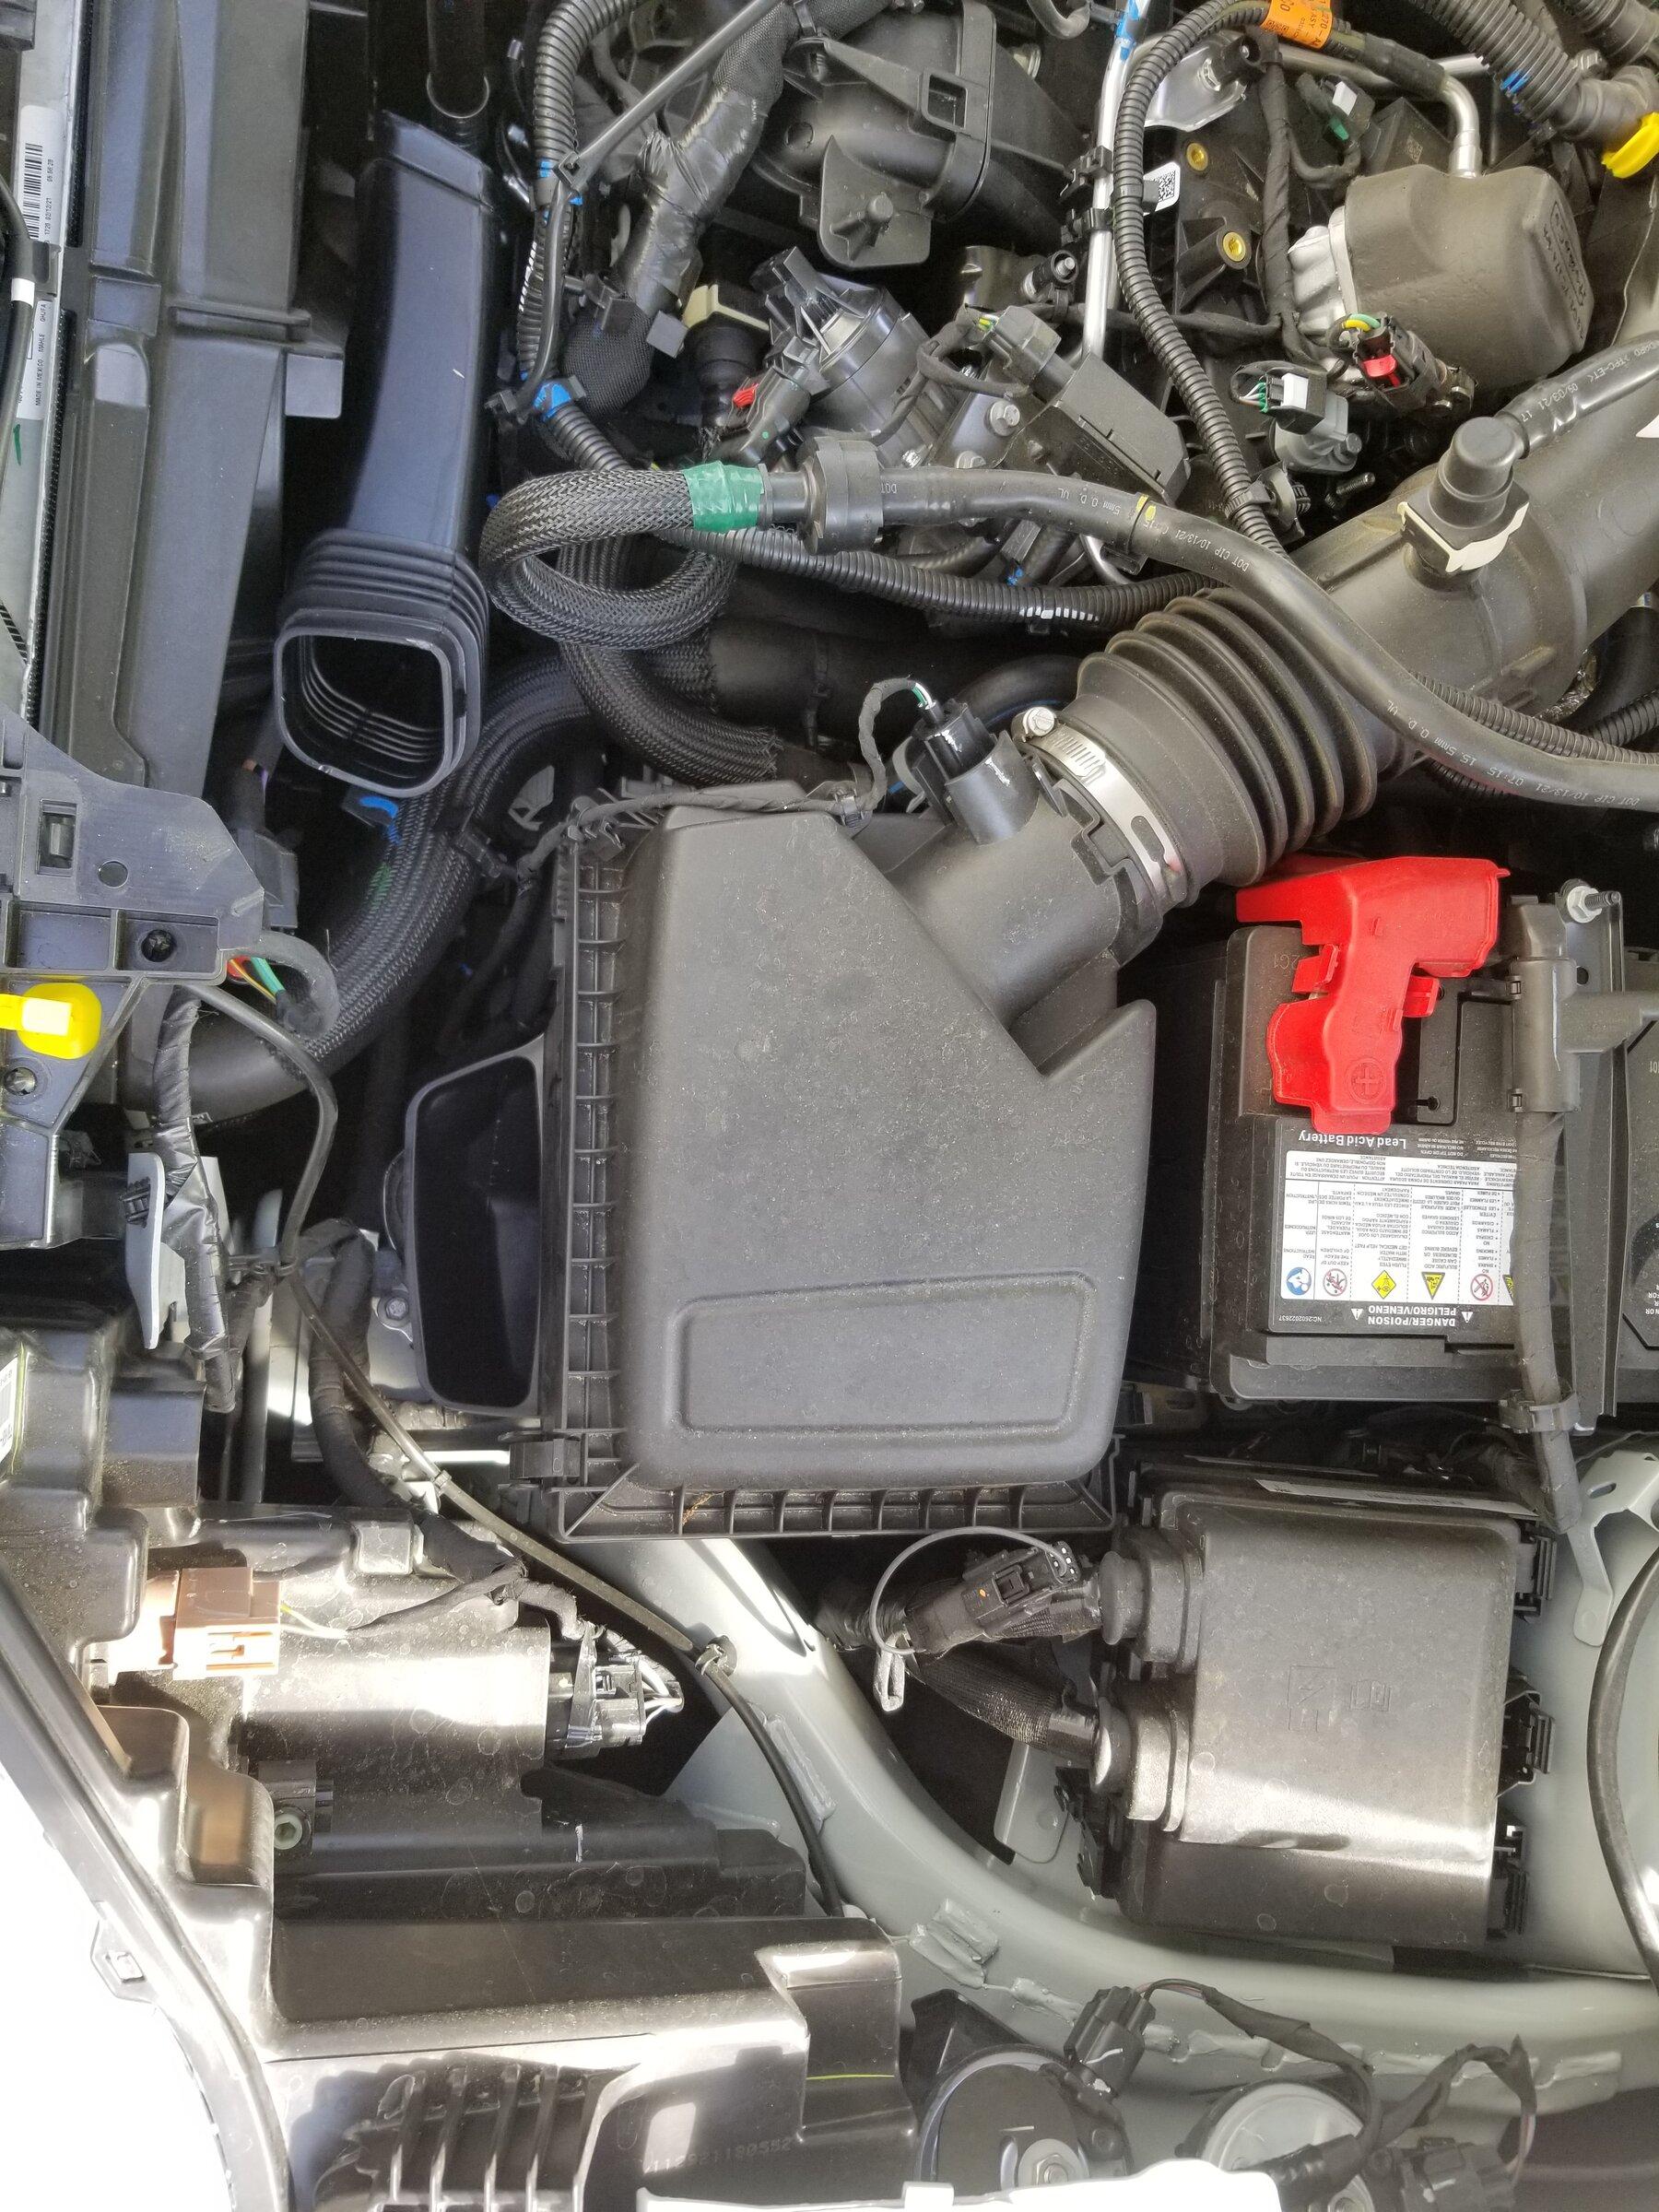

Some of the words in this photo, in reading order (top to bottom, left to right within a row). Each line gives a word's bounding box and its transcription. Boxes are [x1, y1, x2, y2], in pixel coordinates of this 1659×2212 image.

[1519, 410, 1533, 423] 17
[1057, 488, 1069, 499] UL
[1175, 529, 1211, 551] 10/13/21
[1214, 546, 1230, 560] CIP
[1231, 557, 1250, 572] DOT
[1386, 700, 1399, 716] UL
[1486, 766, 1525, 786] 07:15
[1534, 783, 1589, 800] 10/13/21
[1594, 794, 1616, 804] CIP
[1619, 795, 1641, 806] DOT
[1298, 1130, 1344, 1145] Battery
[1347, 1135, 1375, 1147] Acid
[1377, 1137, 1406, 1150] Lead
[1368, 1305, 1456, 1316] PELIGRO/VENENO
[1368, 1316, 1455, 1326] DANGER/POISON
